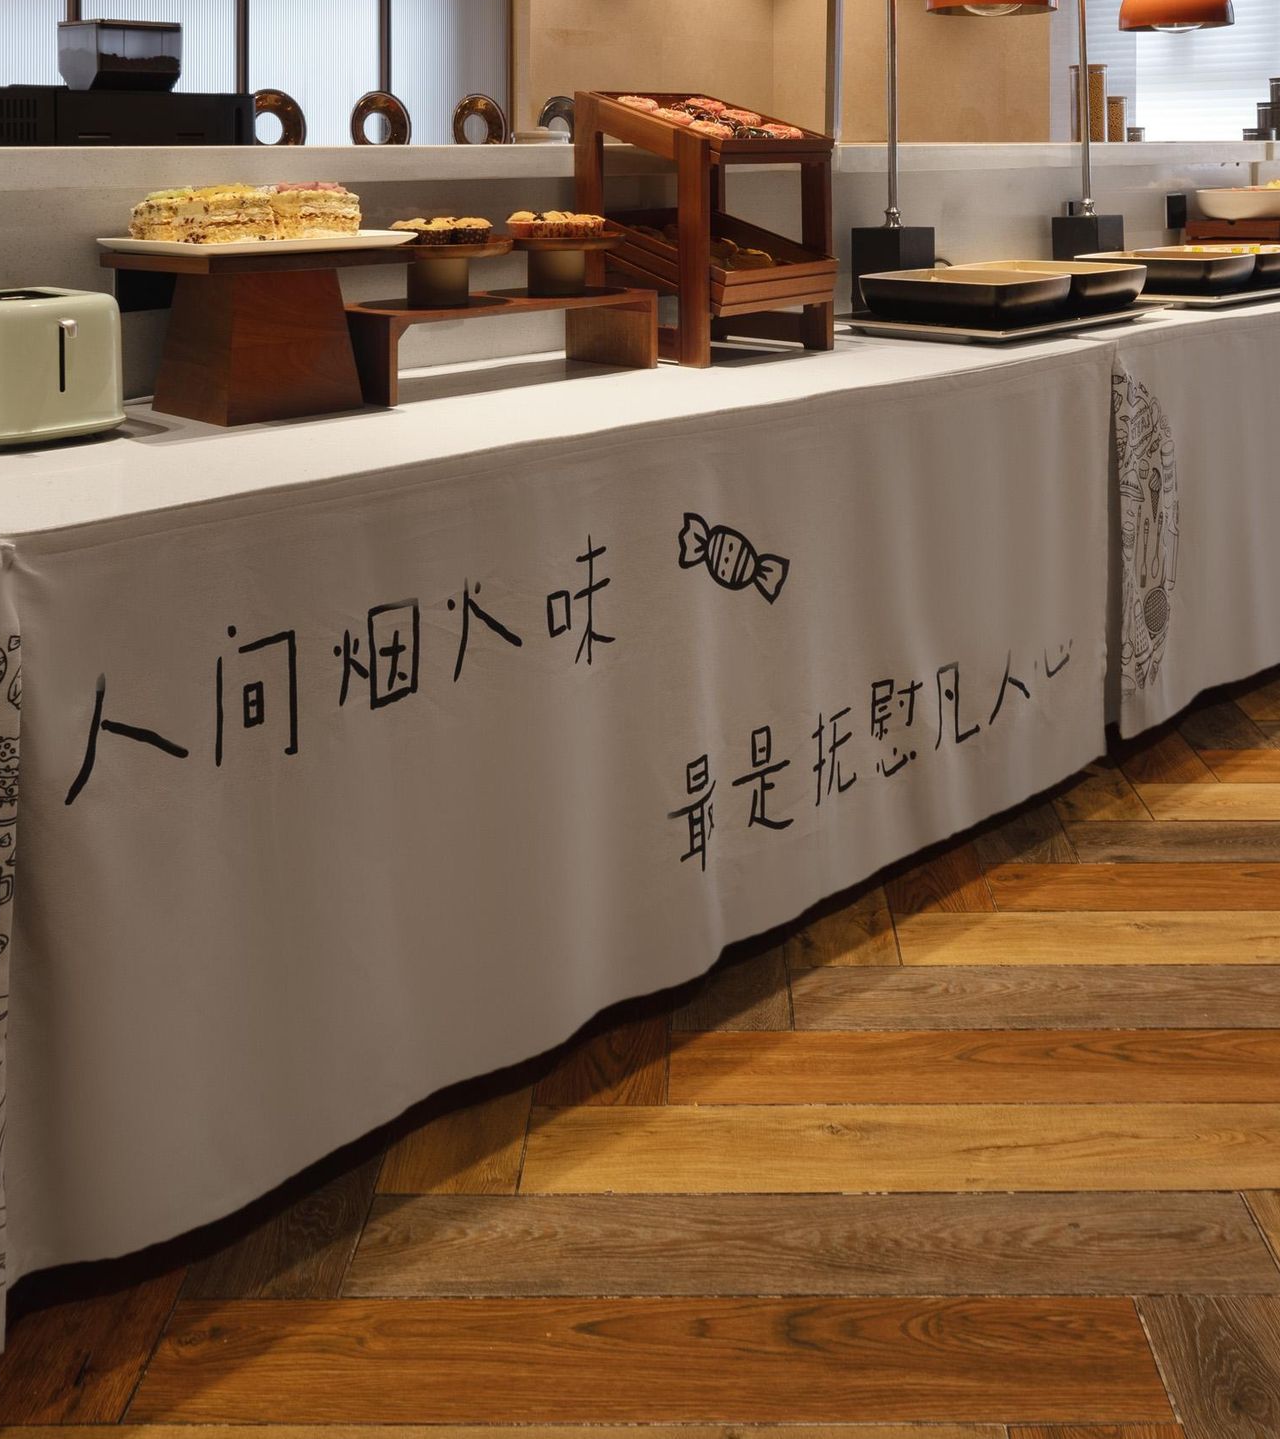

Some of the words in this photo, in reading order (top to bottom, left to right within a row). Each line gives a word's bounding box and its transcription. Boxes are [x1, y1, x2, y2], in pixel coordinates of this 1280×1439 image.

[64, 533, 617, 806] 人间烟火味
[666, 638, 1073, 872] 最是抚慰凡人心
